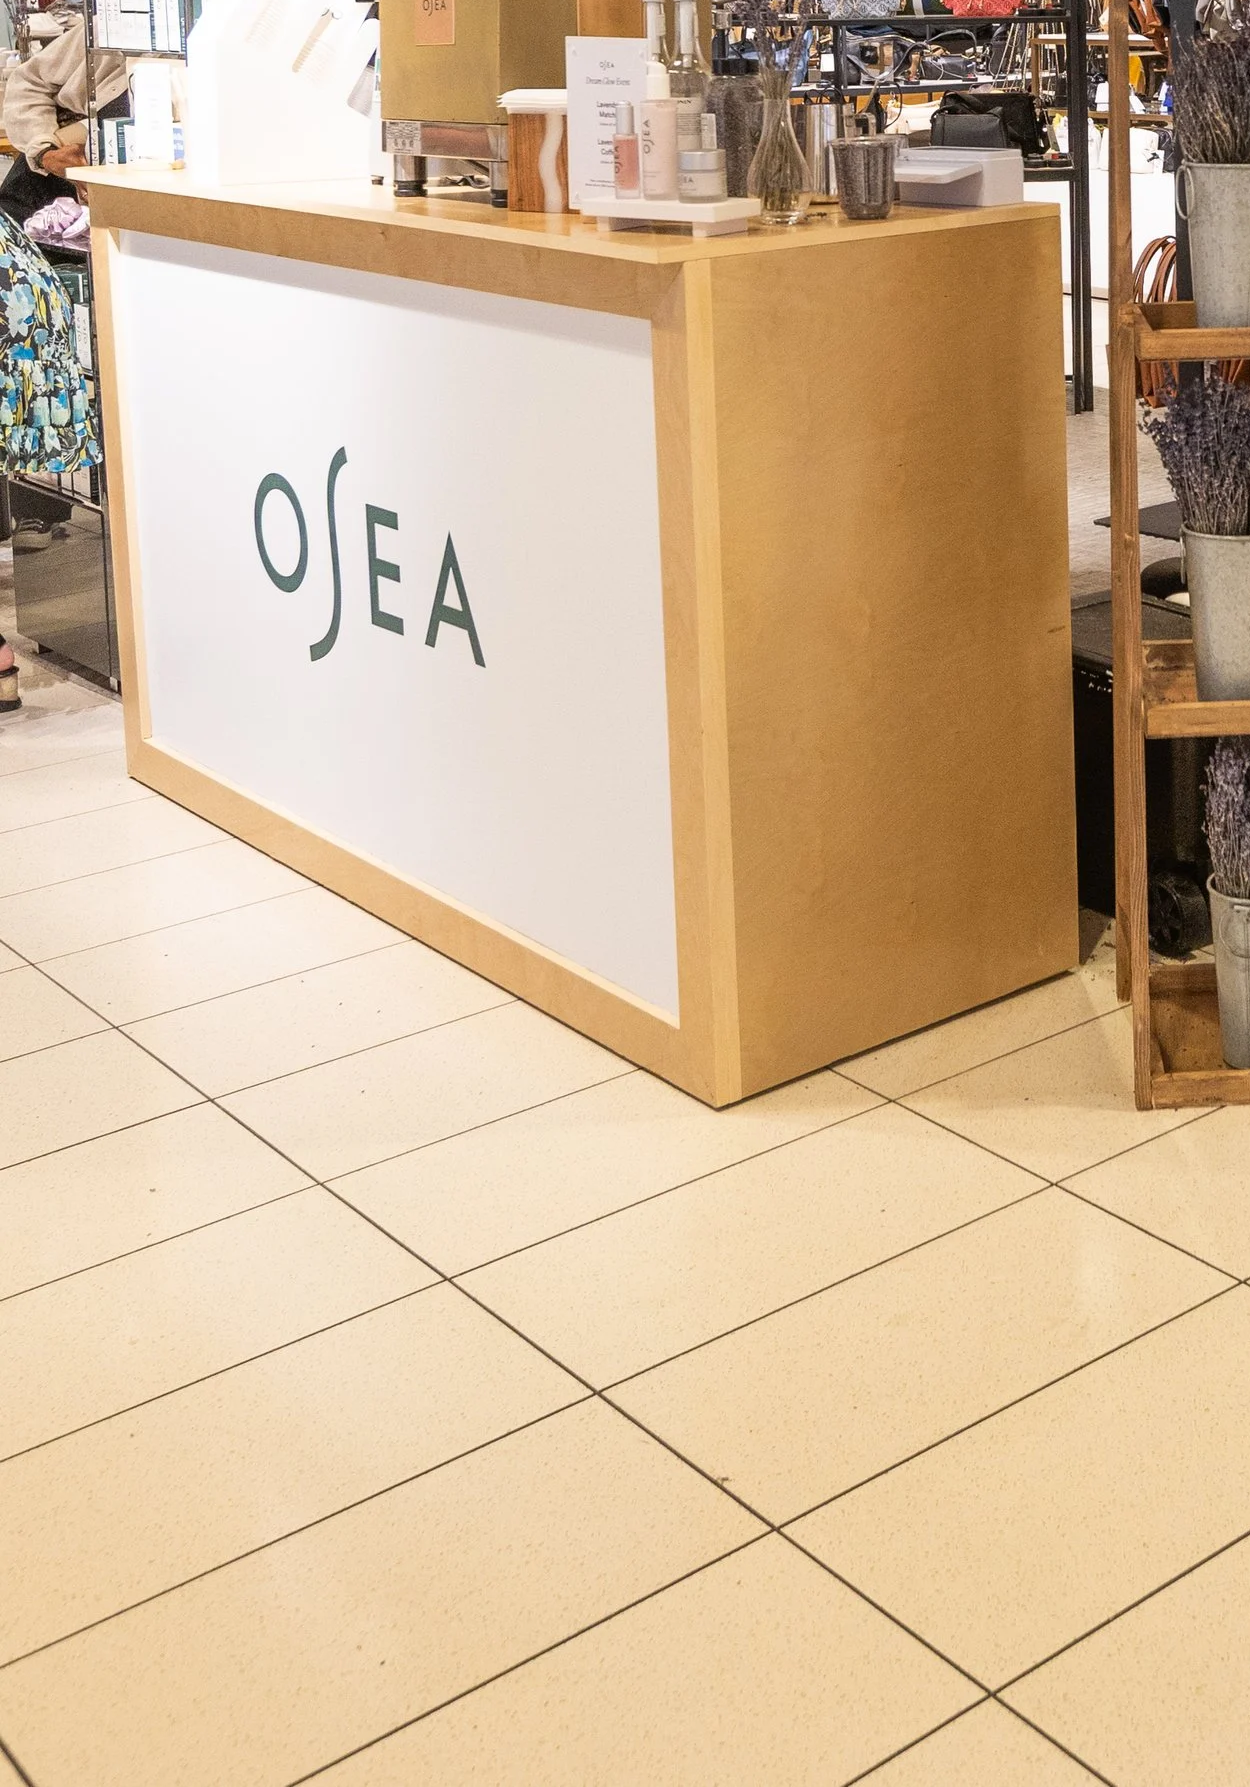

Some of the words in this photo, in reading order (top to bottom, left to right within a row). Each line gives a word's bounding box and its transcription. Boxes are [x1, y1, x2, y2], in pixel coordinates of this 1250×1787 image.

[599, 60, 615, 71] OSEA
[586, 77, 602, 85] Dream
[602, 77, 615, 86] Glow
[616, 77, 631, 86] Event
[642, 119, 655, 154] OSEA
[254, 446, 486, 668] OSEA
